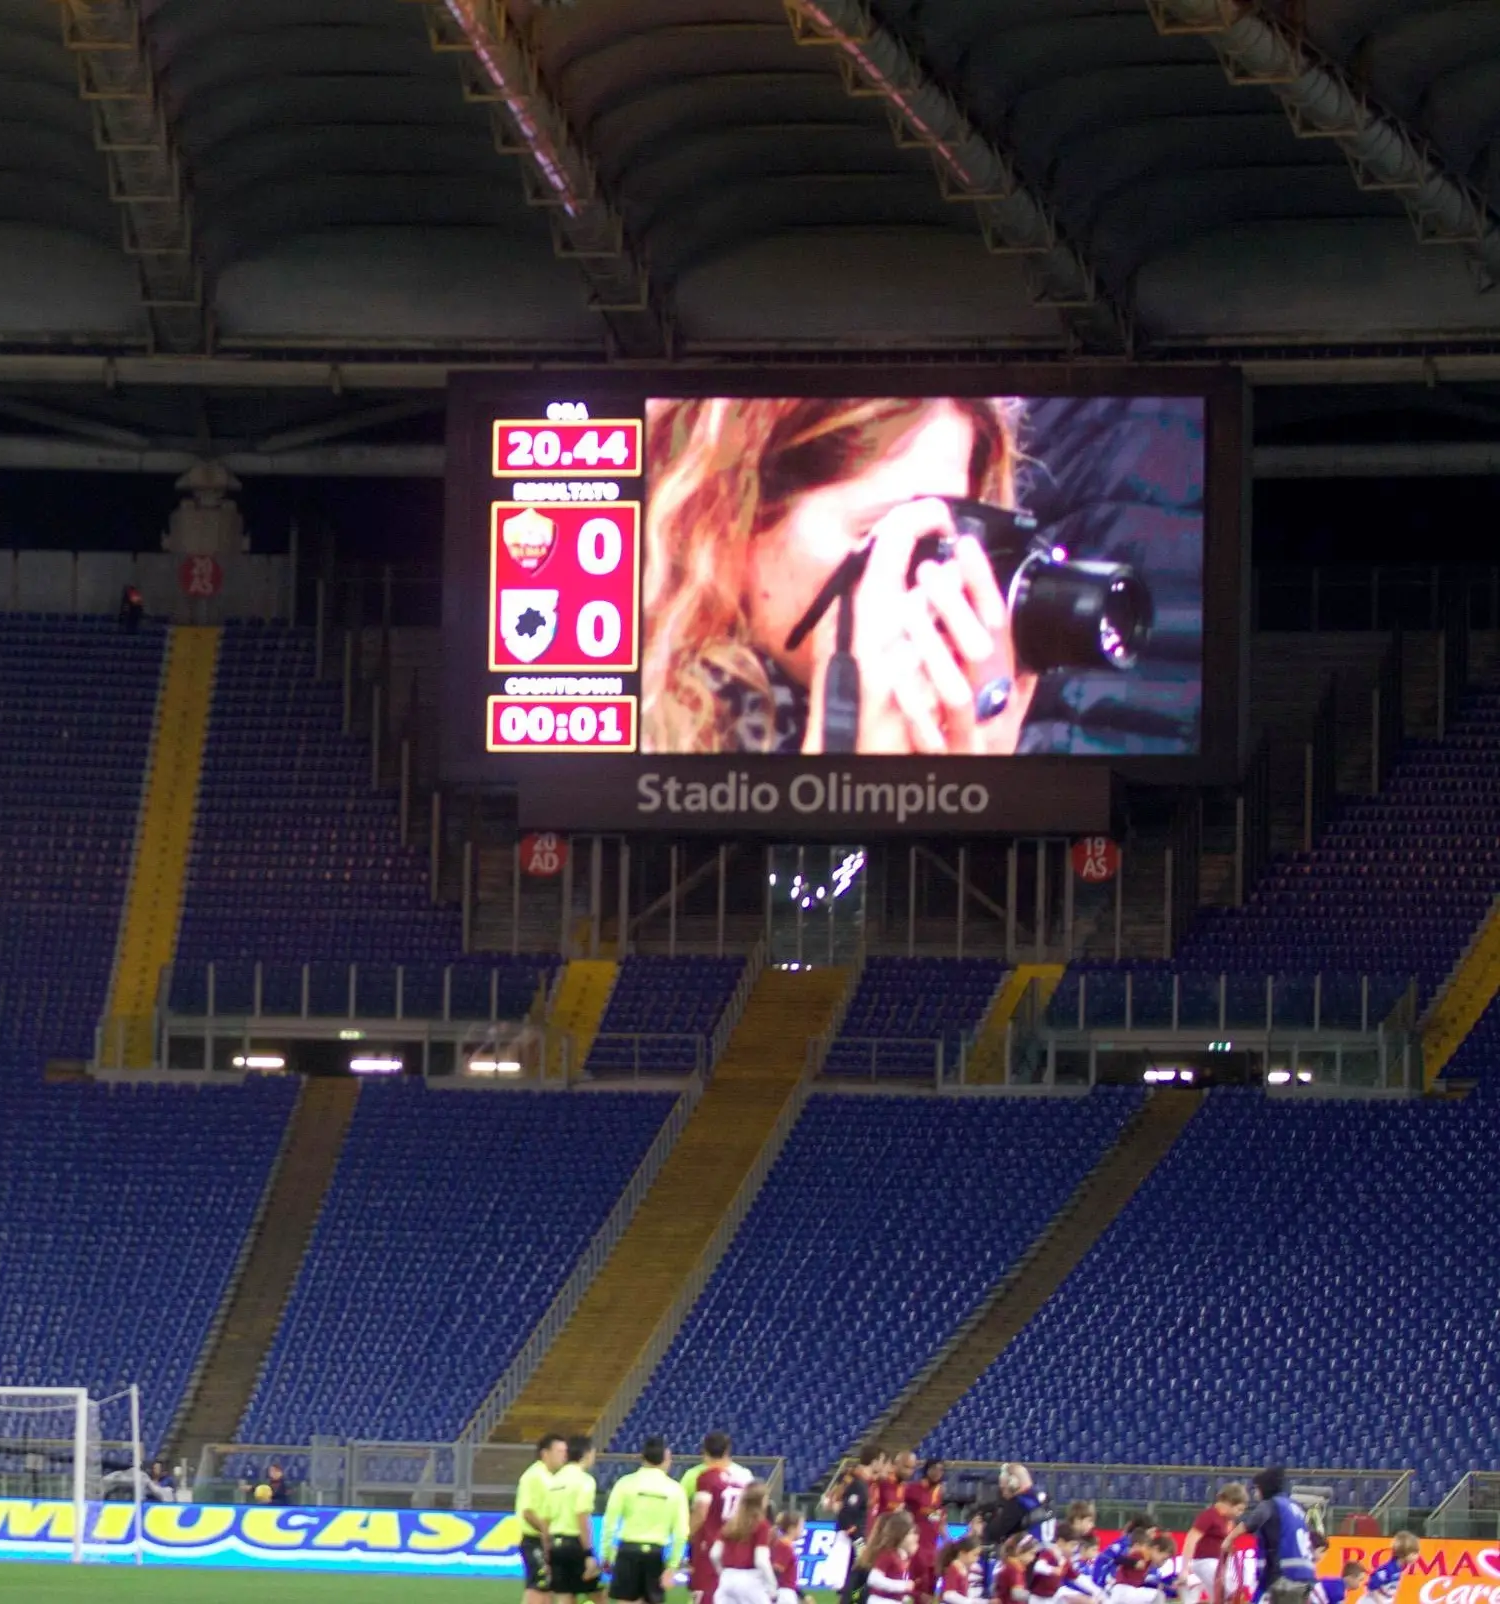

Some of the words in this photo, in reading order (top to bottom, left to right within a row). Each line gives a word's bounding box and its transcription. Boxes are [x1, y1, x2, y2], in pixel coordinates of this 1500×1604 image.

[507, 430, 628, 466] 20.44
[577, 517, 622, 575] 0
[576, 600, 621, 657] 0
[500, 705, 622, 742] 00:01
[637, 770, 780, 813] Stadio
[789, 771, 990, 823] Olimpico
[528, 853, 560, 873] AD
[1083, 857, 1107, 878] AS
